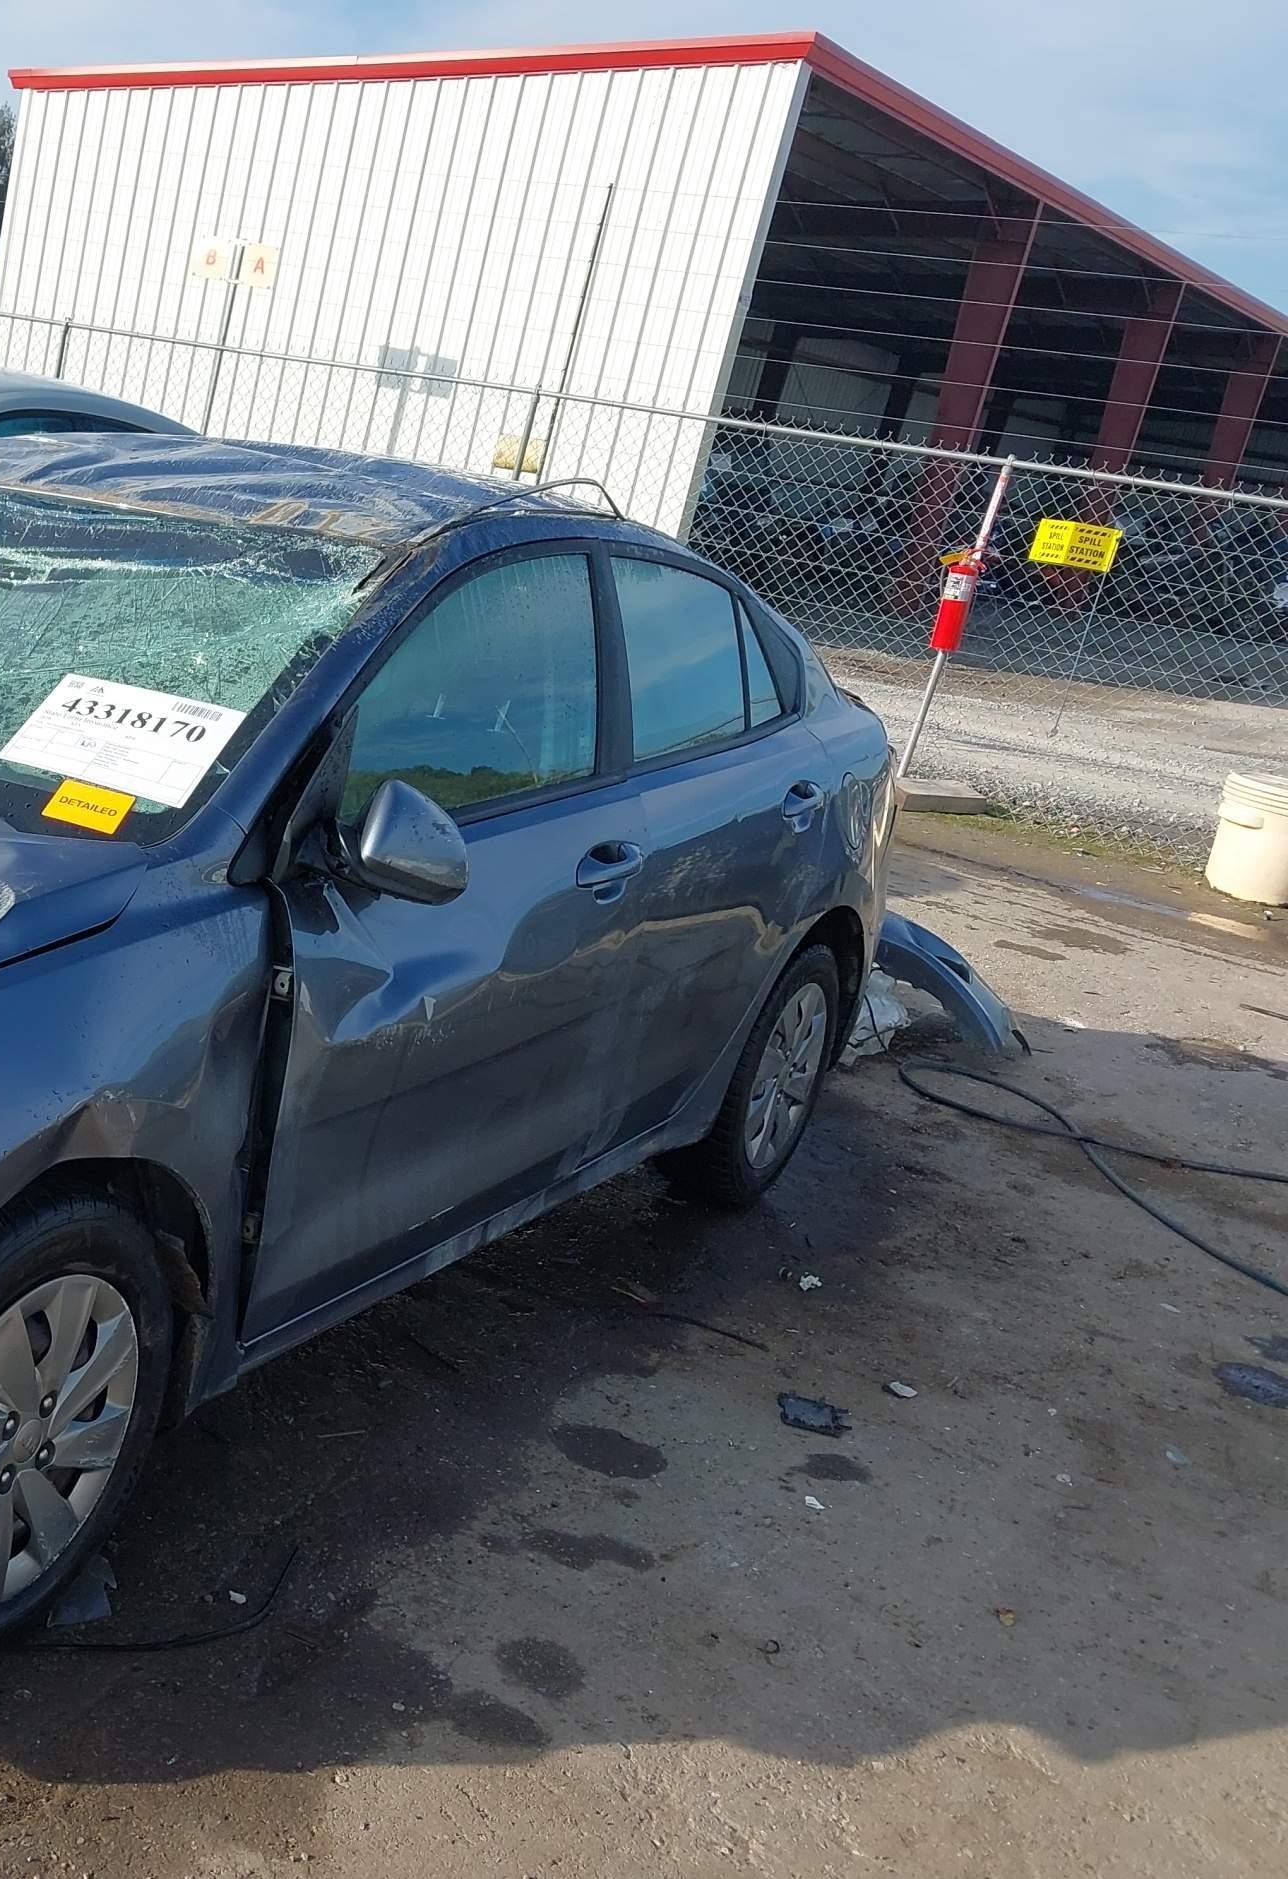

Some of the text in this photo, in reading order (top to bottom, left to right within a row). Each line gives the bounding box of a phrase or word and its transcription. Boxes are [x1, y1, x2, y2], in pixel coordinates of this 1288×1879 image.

[205, 248, 217, 266] B
[253, 256, 265, 275] A
[1048, 531, 1064, 541] SPILL
[1078, 535, 1103, 547] SPILL
[1041, 541, 1065, 552] STATION
[1068, 545, 1106, 559] STATION
[62, 698, 206, 742] 43318170
[58, 794, 118, 818] DETAILED
